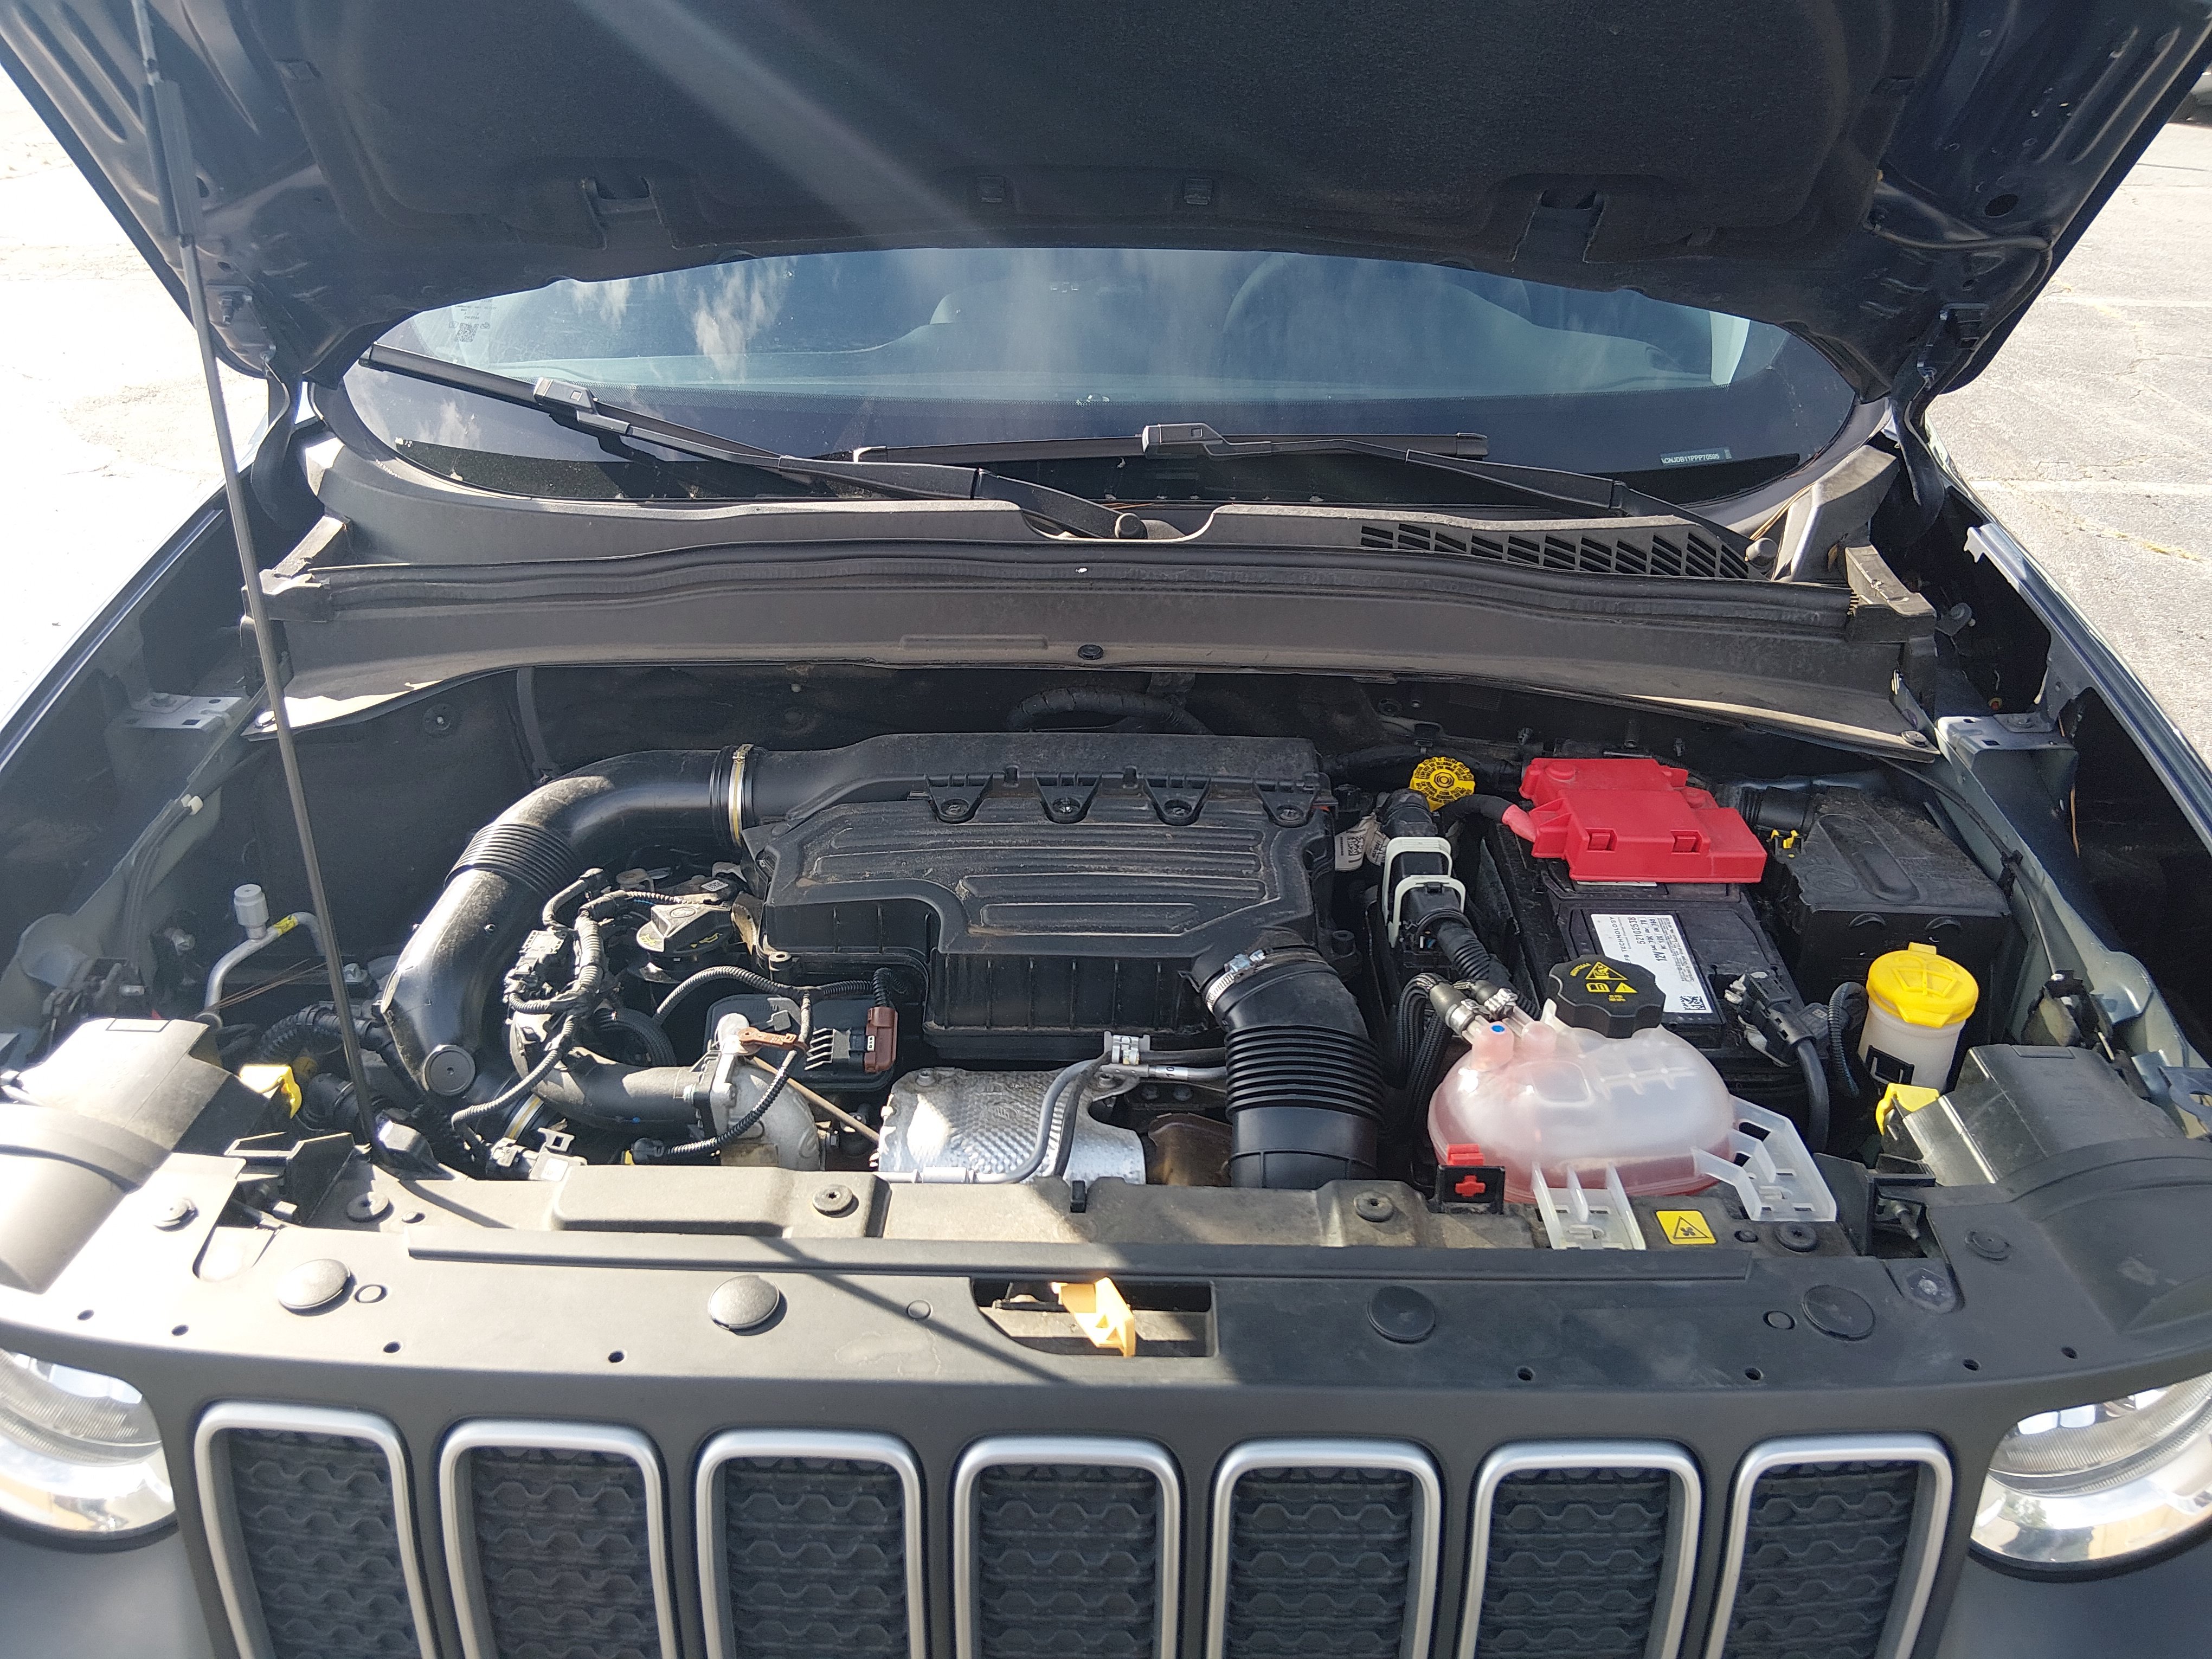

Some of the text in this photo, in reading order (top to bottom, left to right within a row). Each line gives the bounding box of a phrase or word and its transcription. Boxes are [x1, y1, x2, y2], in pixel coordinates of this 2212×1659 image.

[1609, 916, 1631, 963] FB TECHNOLOGY
[1627, 917, 1646, 944] 52102538
[1652, 951, 1668, 961] 12V
